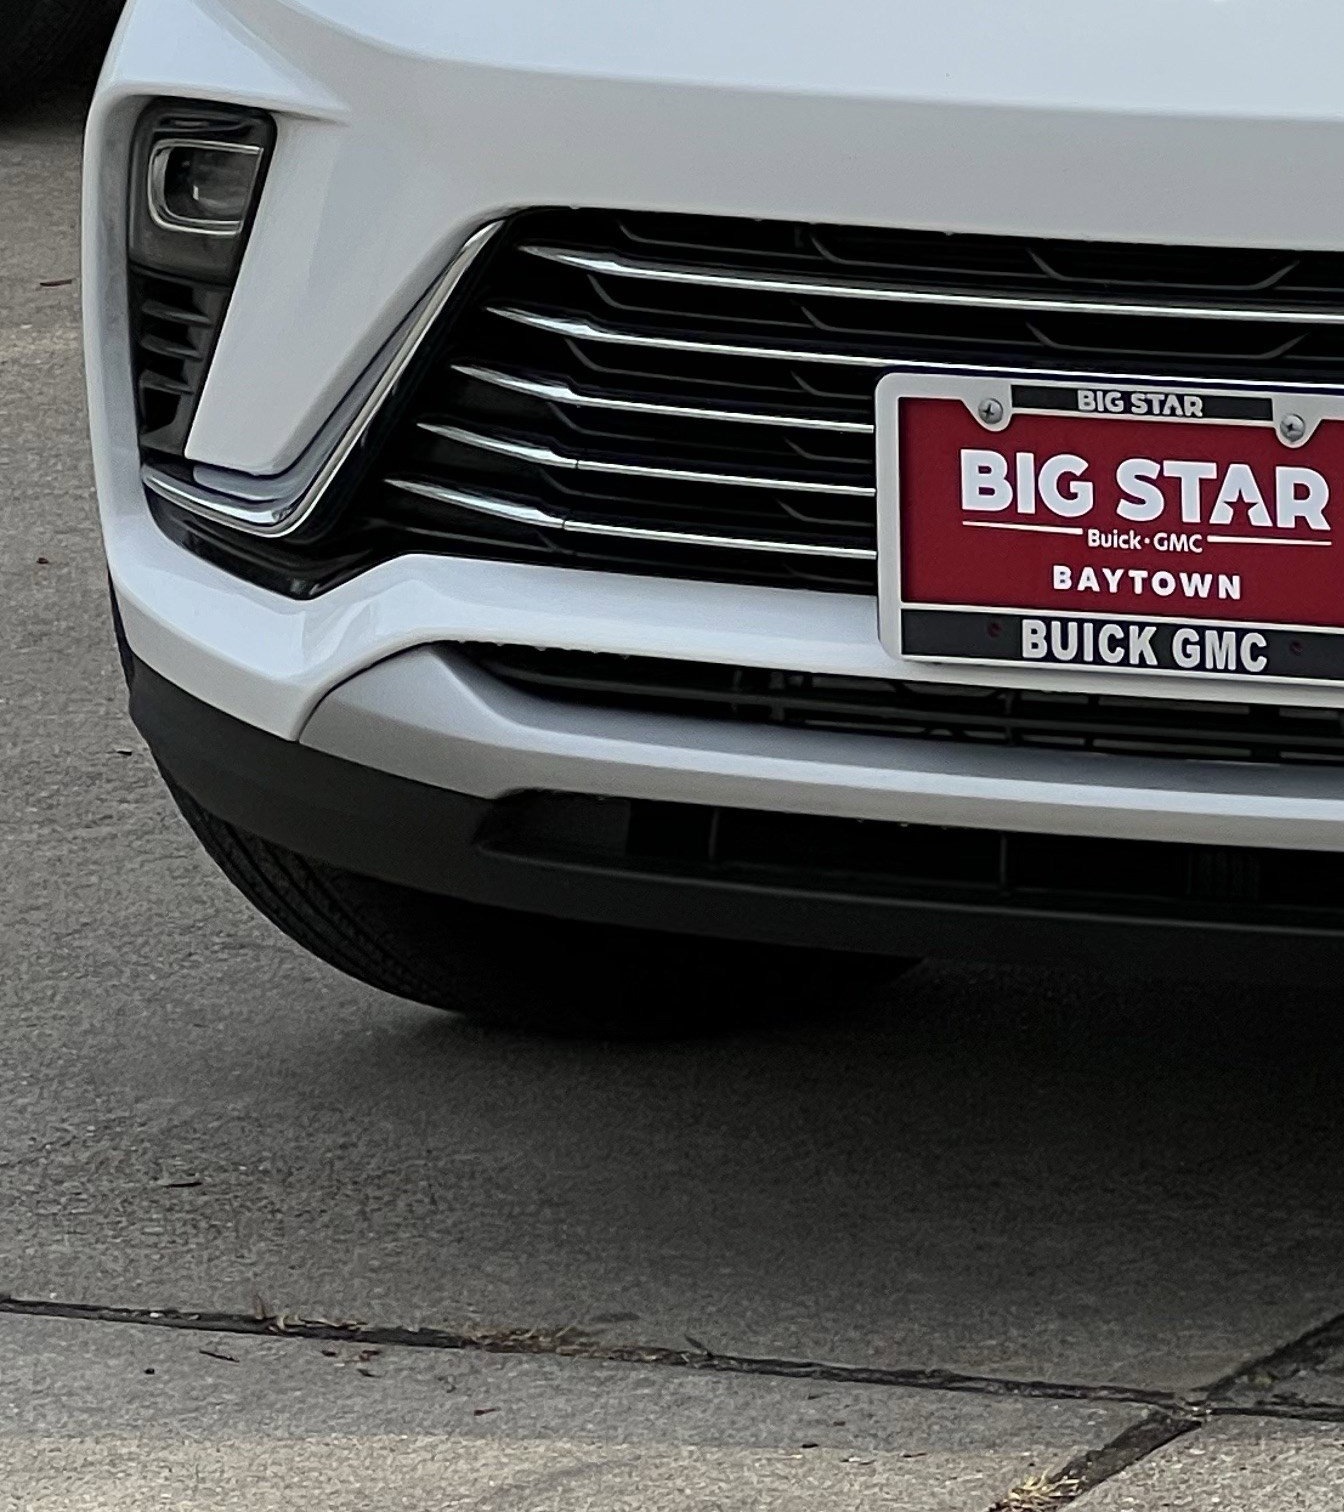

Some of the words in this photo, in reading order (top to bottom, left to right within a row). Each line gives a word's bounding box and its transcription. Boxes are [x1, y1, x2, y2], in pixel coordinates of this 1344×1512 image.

[1077, 389, 1124, 413] BIG
[1130, 392, 1203, 417] STAR
[960, 448, 1094, 518] BIG
[1116, 458, 1331, 531] STAR
[1087, 528, 1142, 550] Buick
[1153, 532, 1203, 553] GMC
[1053, 565, 1241, 600] BAYTOWN
[1022, 618, 1158, 666] BUICK
[1172, 627, 1268, 673] GMC
